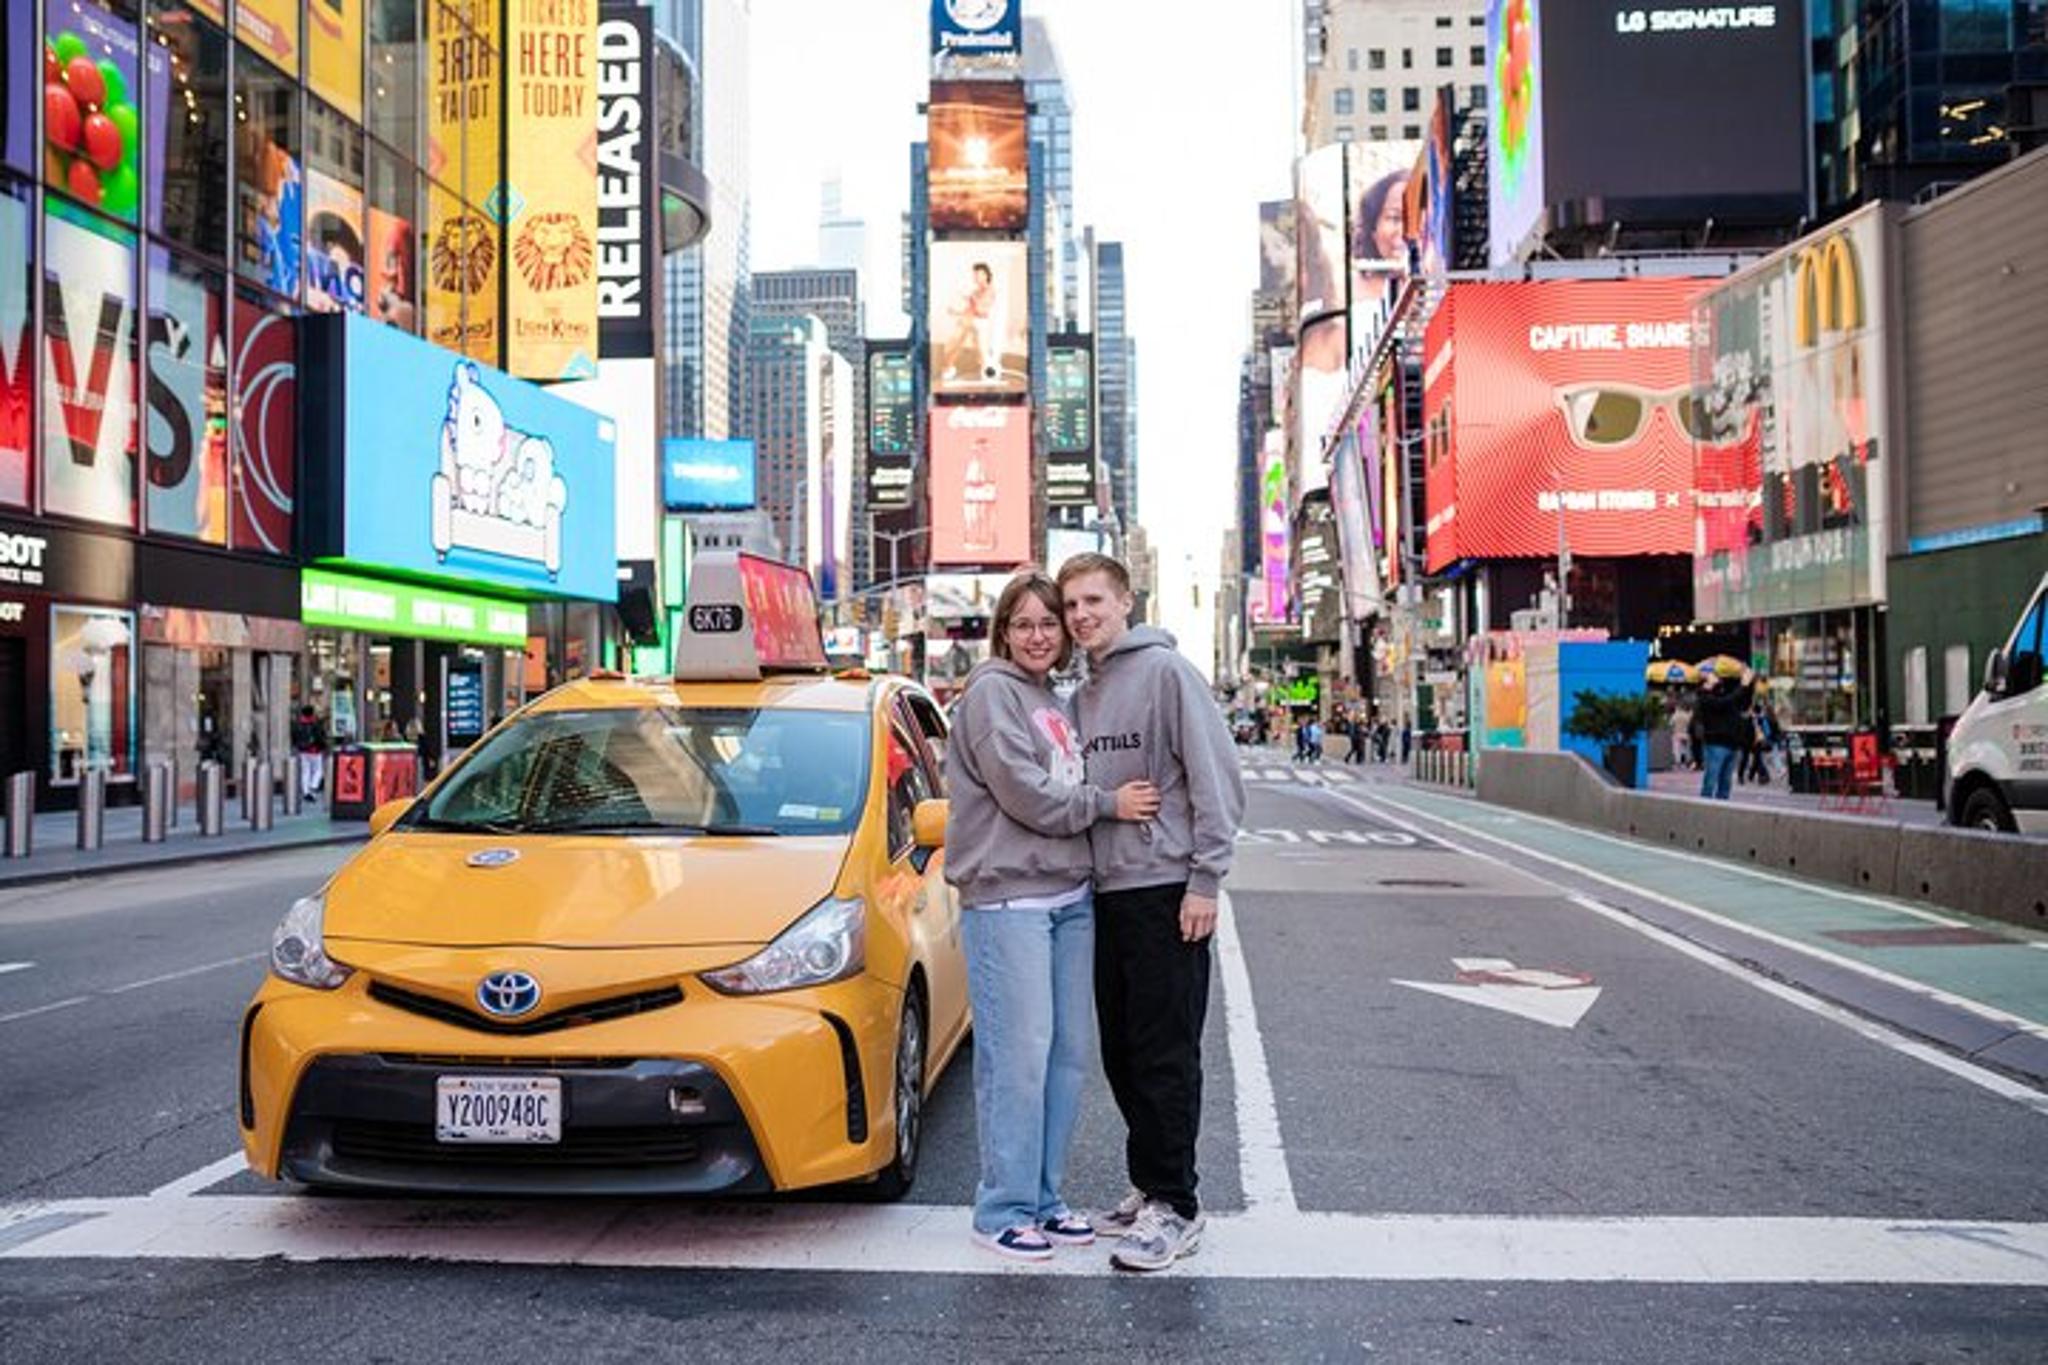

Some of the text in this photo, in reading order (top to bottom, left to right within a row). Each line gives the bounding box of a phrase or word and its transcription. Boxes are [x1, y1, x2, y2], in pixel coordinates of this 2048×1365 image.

[1617, 6, 1776, 32] LG SIGNATURE
[519, 31, 586, 78] HERE
[522, 82, 585, 118] TODAY
[597, 19, 642, 317] RELEASED
[1530, 325, 1622, 351] CAPTURE,
[1626, 322, 1691, 349] SHARE
[448, 1093, 550, 1127] Y200948C
